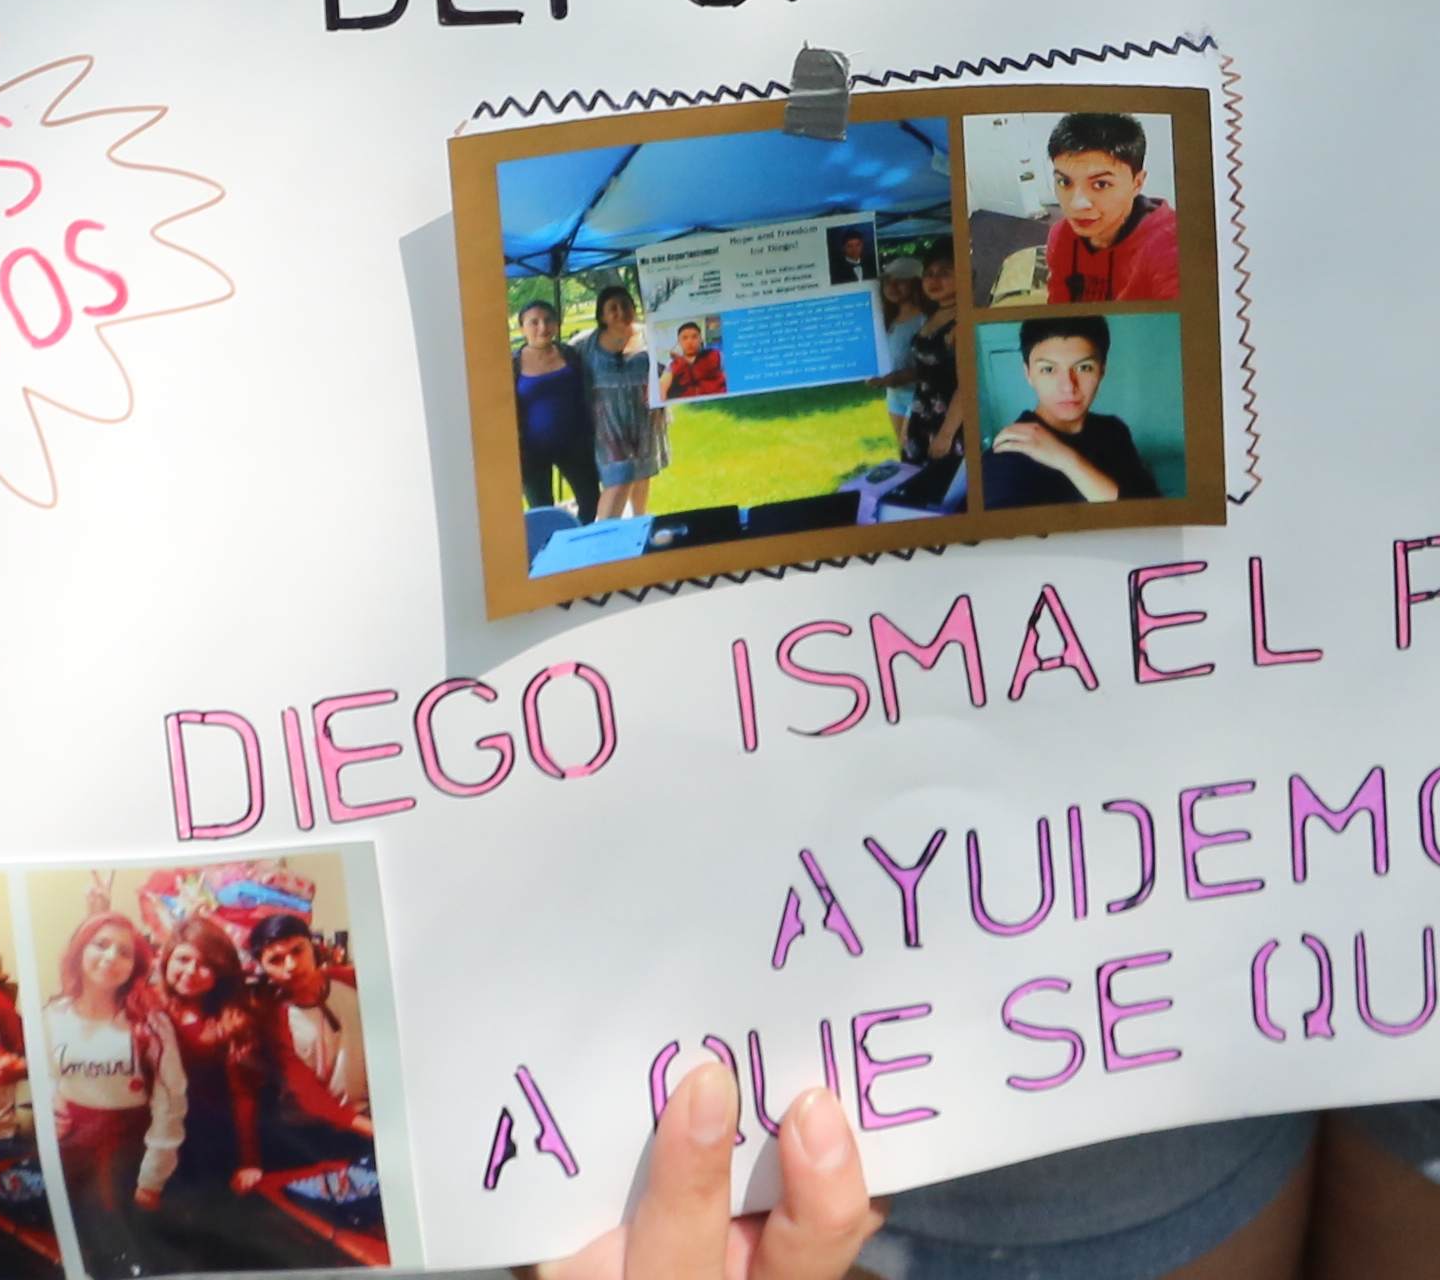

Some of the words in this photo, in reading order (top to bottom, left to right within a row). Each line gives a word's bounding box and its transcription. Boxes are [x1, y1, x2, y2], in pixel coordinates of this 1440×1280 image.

[164, 660, 617, 841] DIEGO
[732, 555, 1323, 754] ISMAEL
[483, 1064, 580, 1191] A
[648, 1003, 941, 1146] QUE
[1001, 950, 1183, 1092] SE
